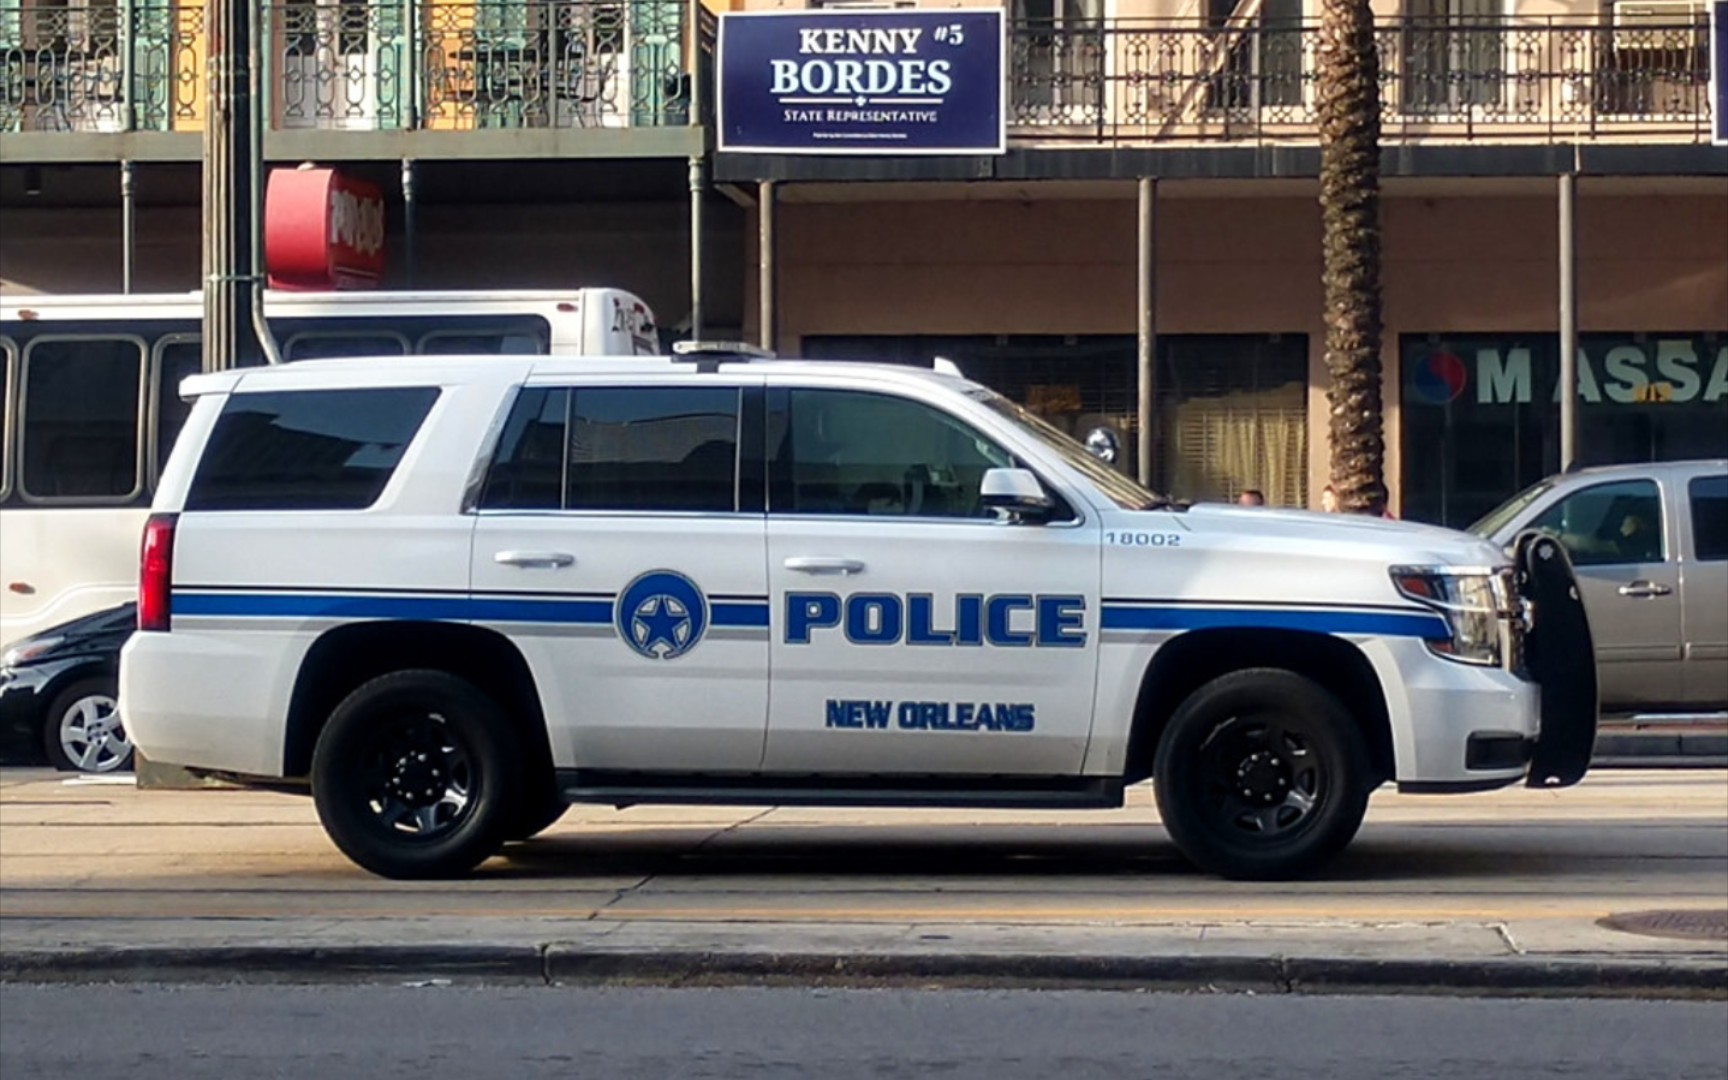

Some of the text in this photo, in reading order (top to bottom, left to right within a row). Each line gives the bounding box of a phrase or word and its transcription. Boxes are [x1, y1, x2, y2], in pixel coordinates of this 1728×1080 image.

[799, 24, 964, 54] KENNY #5
[769, 59, 951, 95] BORDES
[1105, 531, 1181, 547] 18002
[783, 590, 1087, 648] POLICE
[825, 699, 1035, 732] NEW ORLEANS
